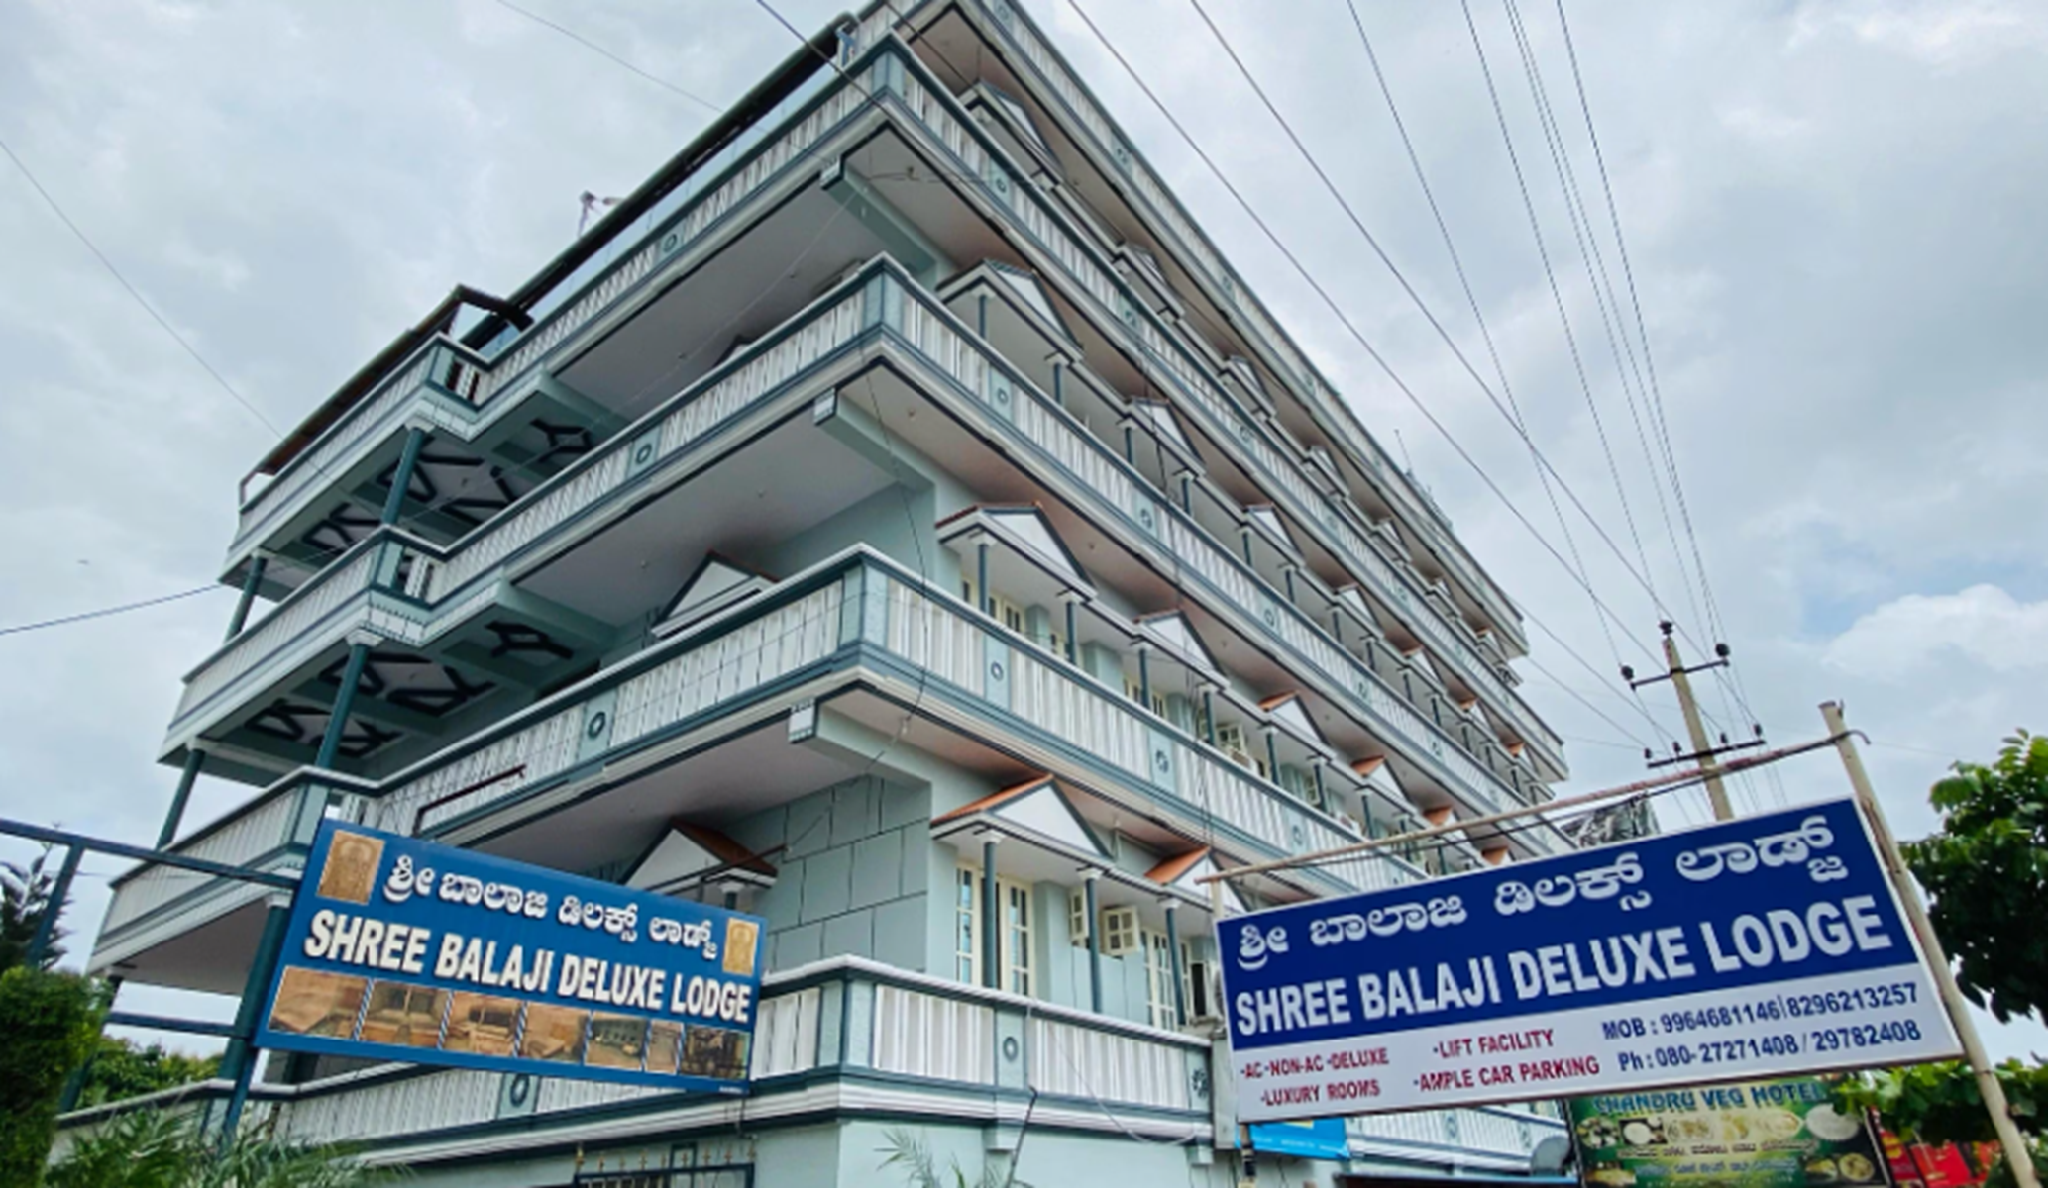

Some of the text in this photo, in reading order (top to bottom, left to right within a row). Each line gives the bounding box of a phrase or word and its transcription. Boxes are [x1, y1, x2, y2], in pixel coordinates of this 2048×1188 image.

[383, 854, 719, 961] ಶ್ರೀ ಬಾಲಾಜಿ ಡಿಲಕ್ಸ್ ಲಾಡ್ಜ್
[1237, 815, 1850, 971] ಶ್ರೀ ಬಾಲಾಜಿ ಡಿಲಕ್ಸ್ ಲಾಡ್ಜ್
[304, 908, 752, 1023] SHREE BALAJI DELUXE LODGE
[1236, 895, 1893, 1037] SHREE BALAJI DELUXE LODGE
[1438, 1028, 1555, 1059] LIFT FACILITY
[1602, 1017, 1646, 1041] MOB
[1811, 1019, 1921, 1052] 29782408
[1326, 1078, 1381, 1102] ROOMS
[1419, 1054, 1601, 1092] AMPLE CAR PARKING
[1750, 1081, 1826, 1107] HOTEL
